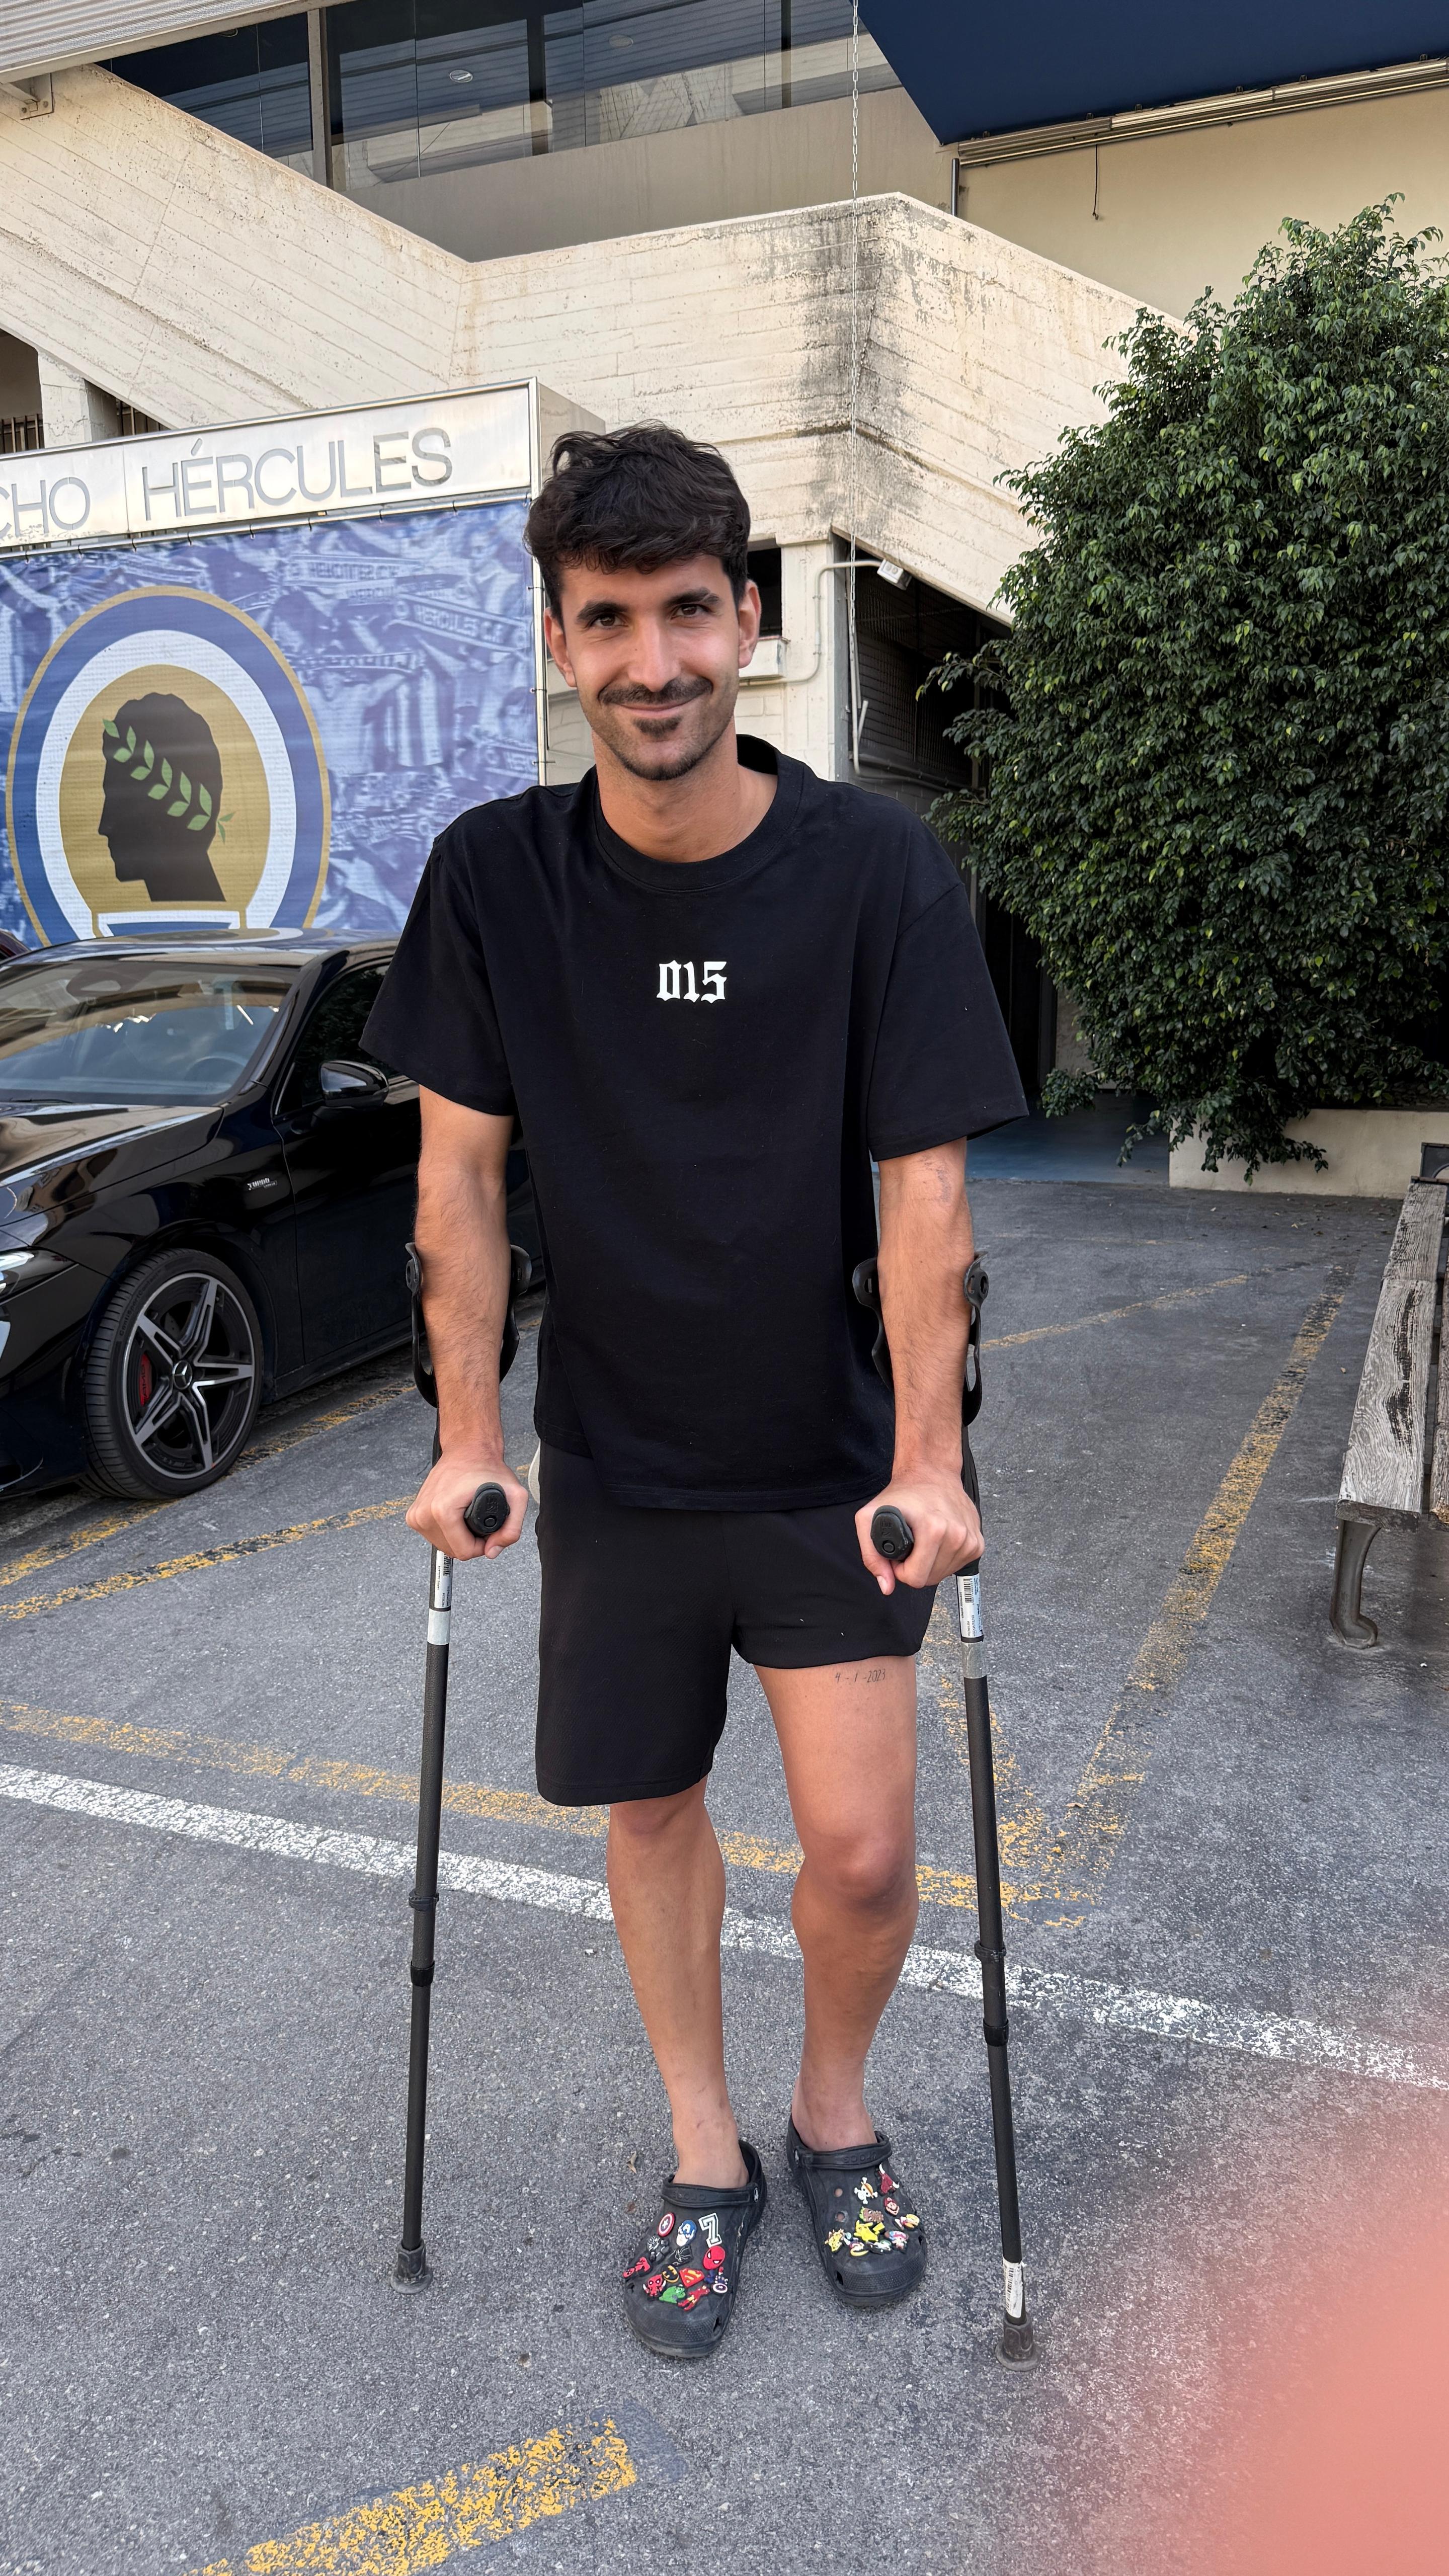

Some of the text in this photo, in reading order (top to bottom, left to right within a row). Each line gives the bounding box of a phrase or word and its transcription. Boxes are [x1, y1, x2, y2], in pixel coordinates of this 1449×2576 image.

[0, 427, 452, 538] HO HÉRCULES
[699, 2213, 722, 2248] 7
